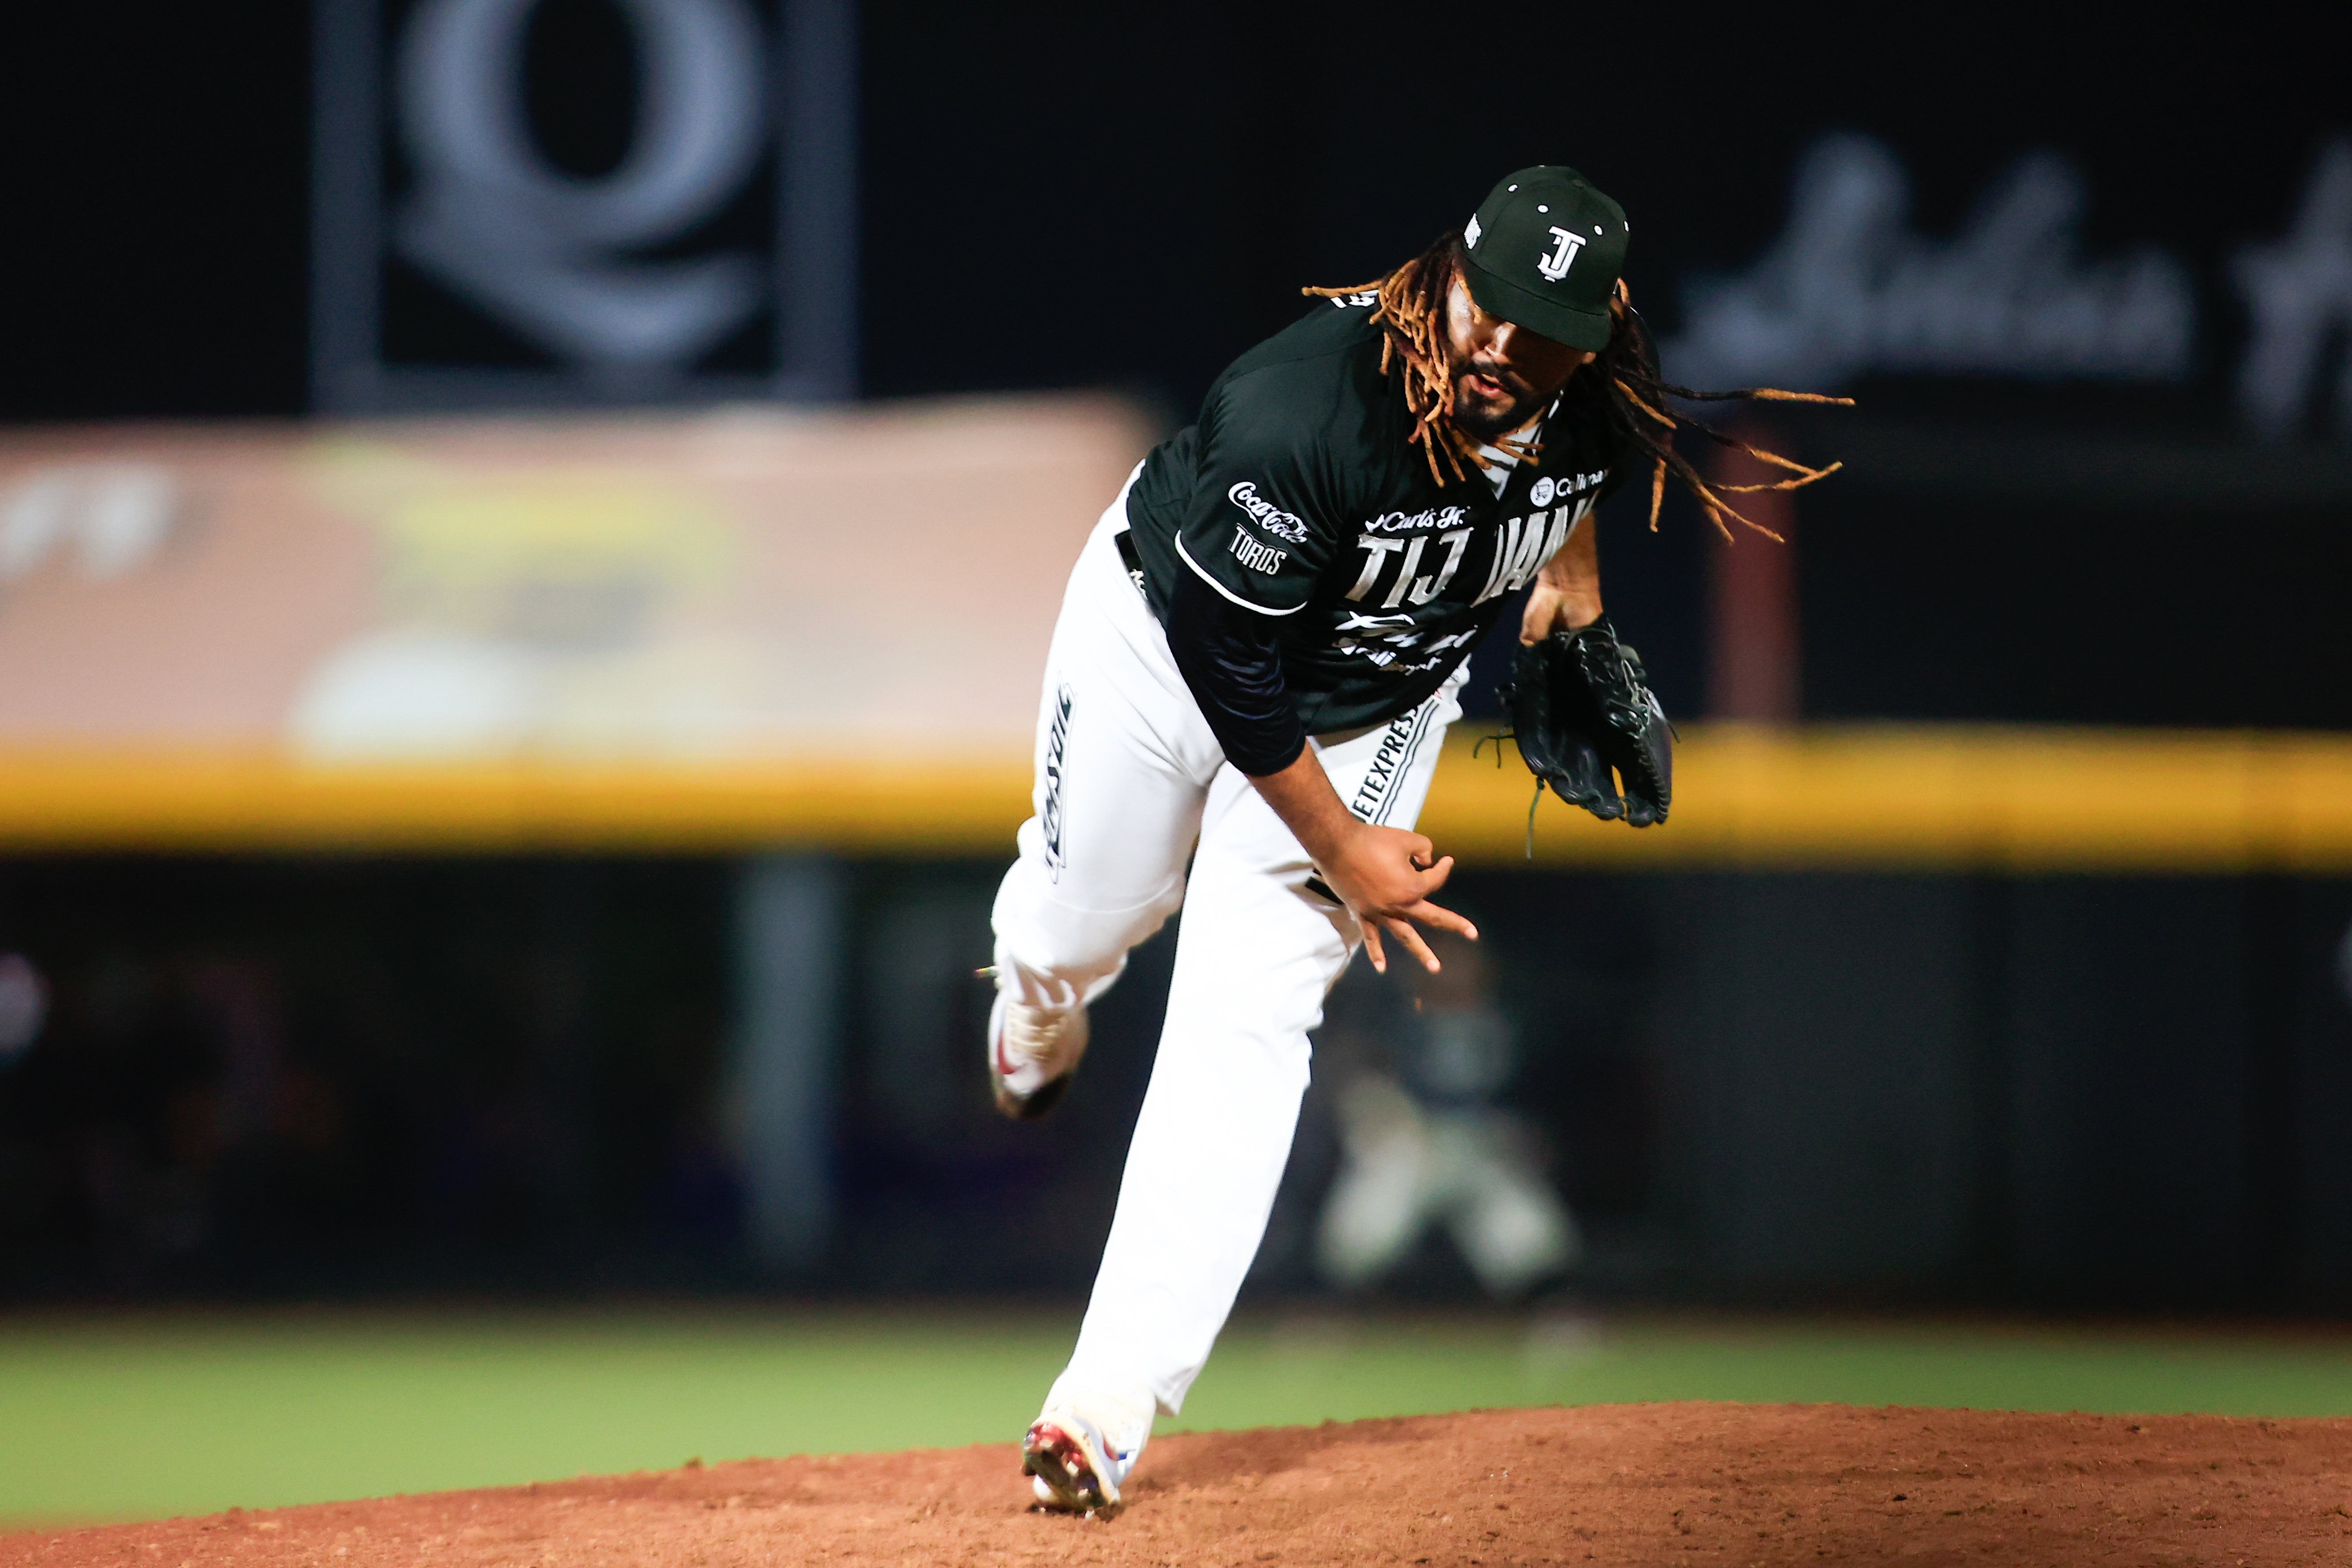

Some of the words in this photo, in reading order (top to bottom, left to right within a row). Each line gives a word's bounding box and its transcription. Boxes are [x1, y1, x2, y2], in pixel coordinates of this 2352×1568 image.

[1382, 508, 1437, 532] Carl's
[1436, 506, 1463, 529] Jr.
[1227, 522, 1289, 575] TOROS
